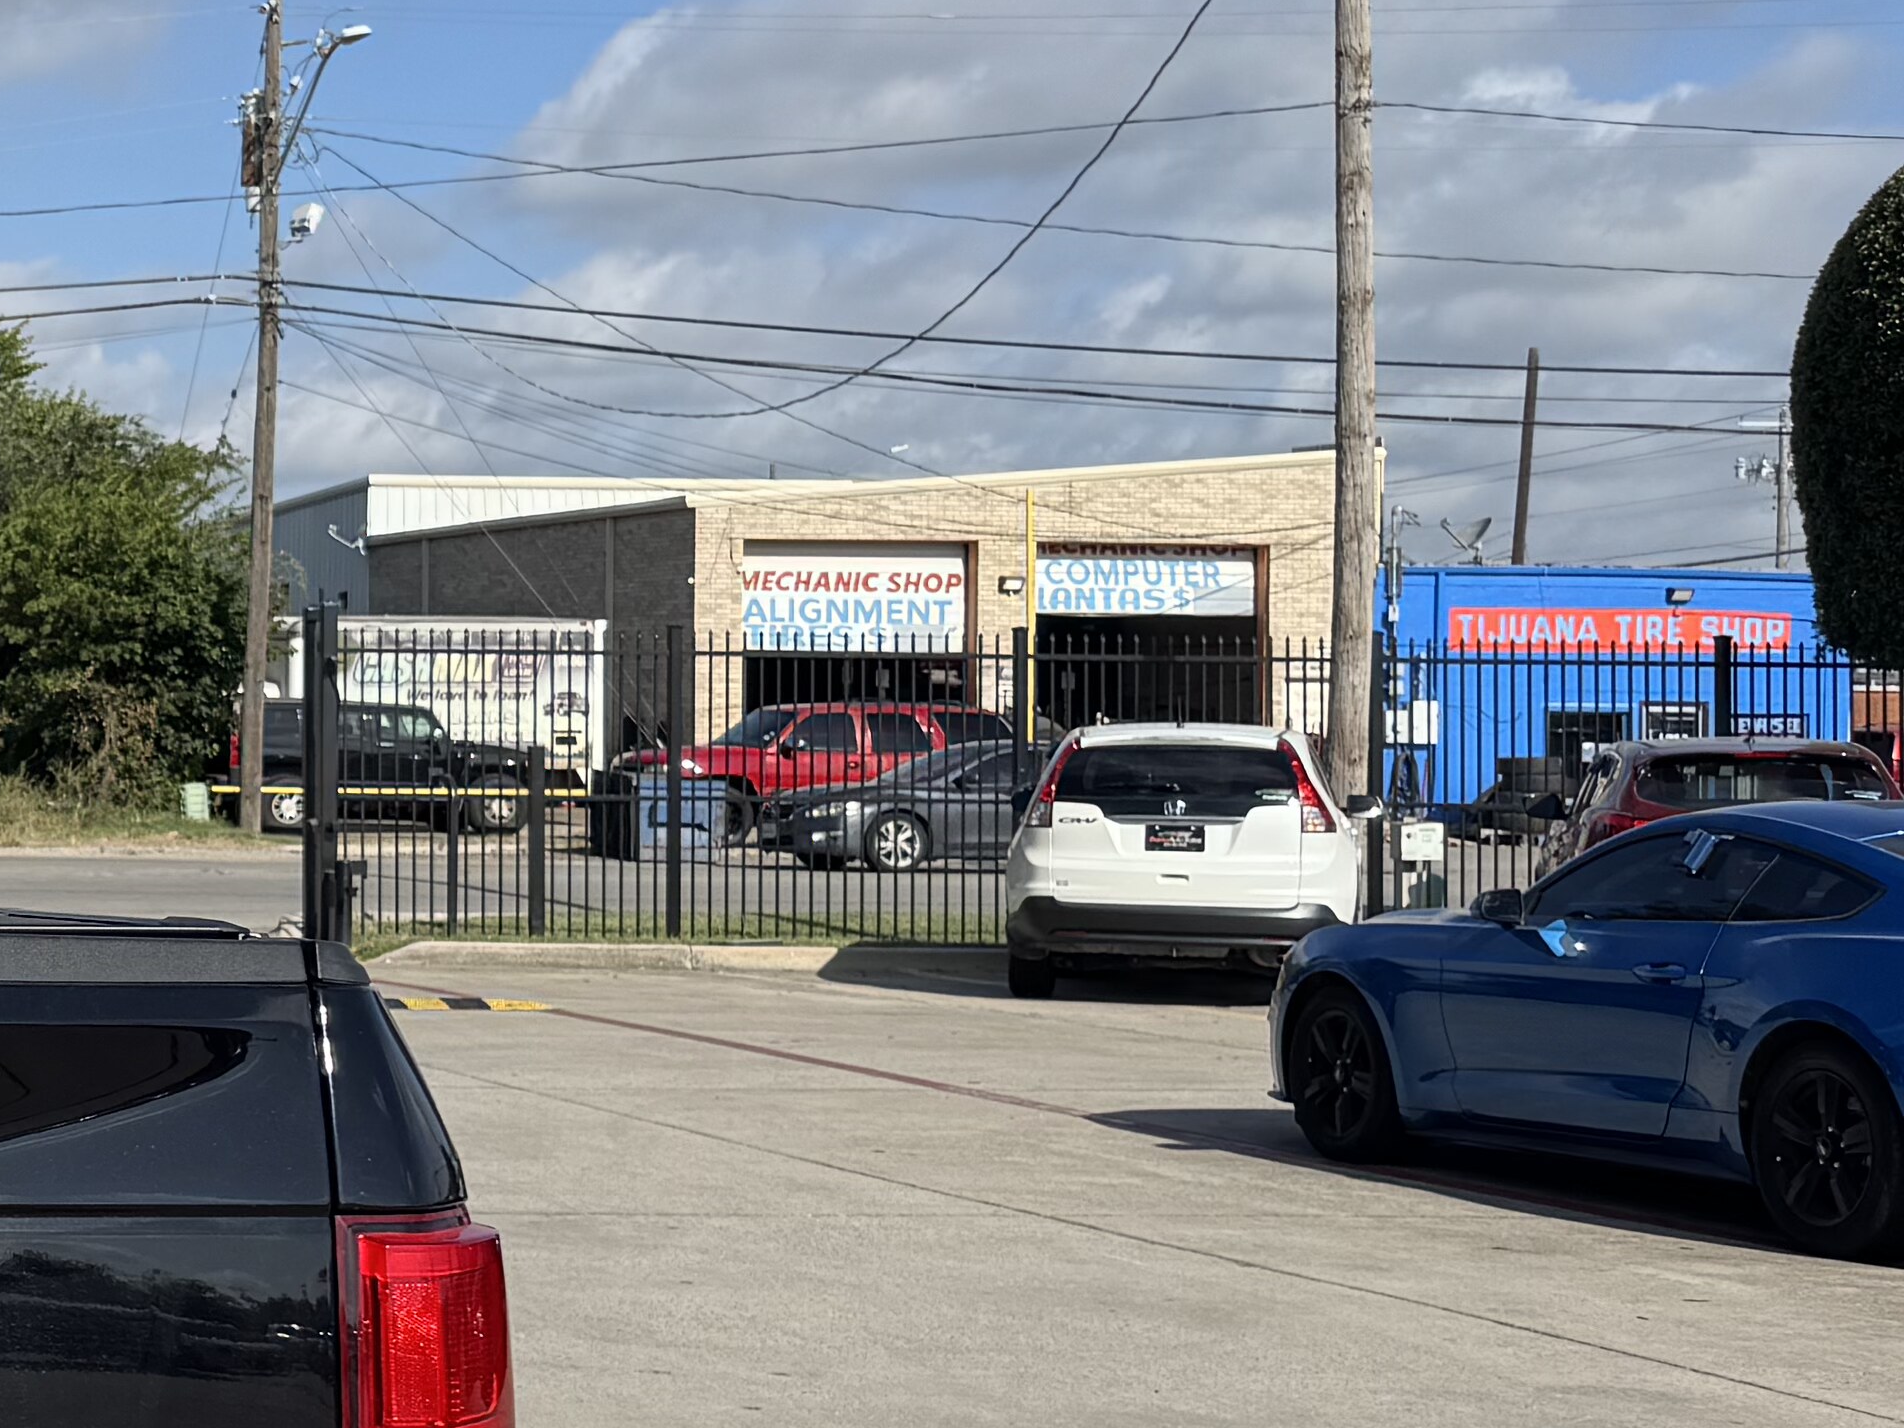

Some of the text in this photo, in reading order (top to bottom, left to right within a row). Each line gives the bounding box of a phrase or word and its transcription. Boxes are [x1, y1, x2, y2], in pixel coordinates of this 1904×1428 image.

[742, 570, 962, 594] MECHANIC SHOP
[1044, 560, 1221, 587] COMPUTER
[742, 597, 953, 625] ALIGNMENT
[744, 624, 854, 647] TIRES
[1458, 614, 1786, 646] TIJUANA TIRE SHOP
